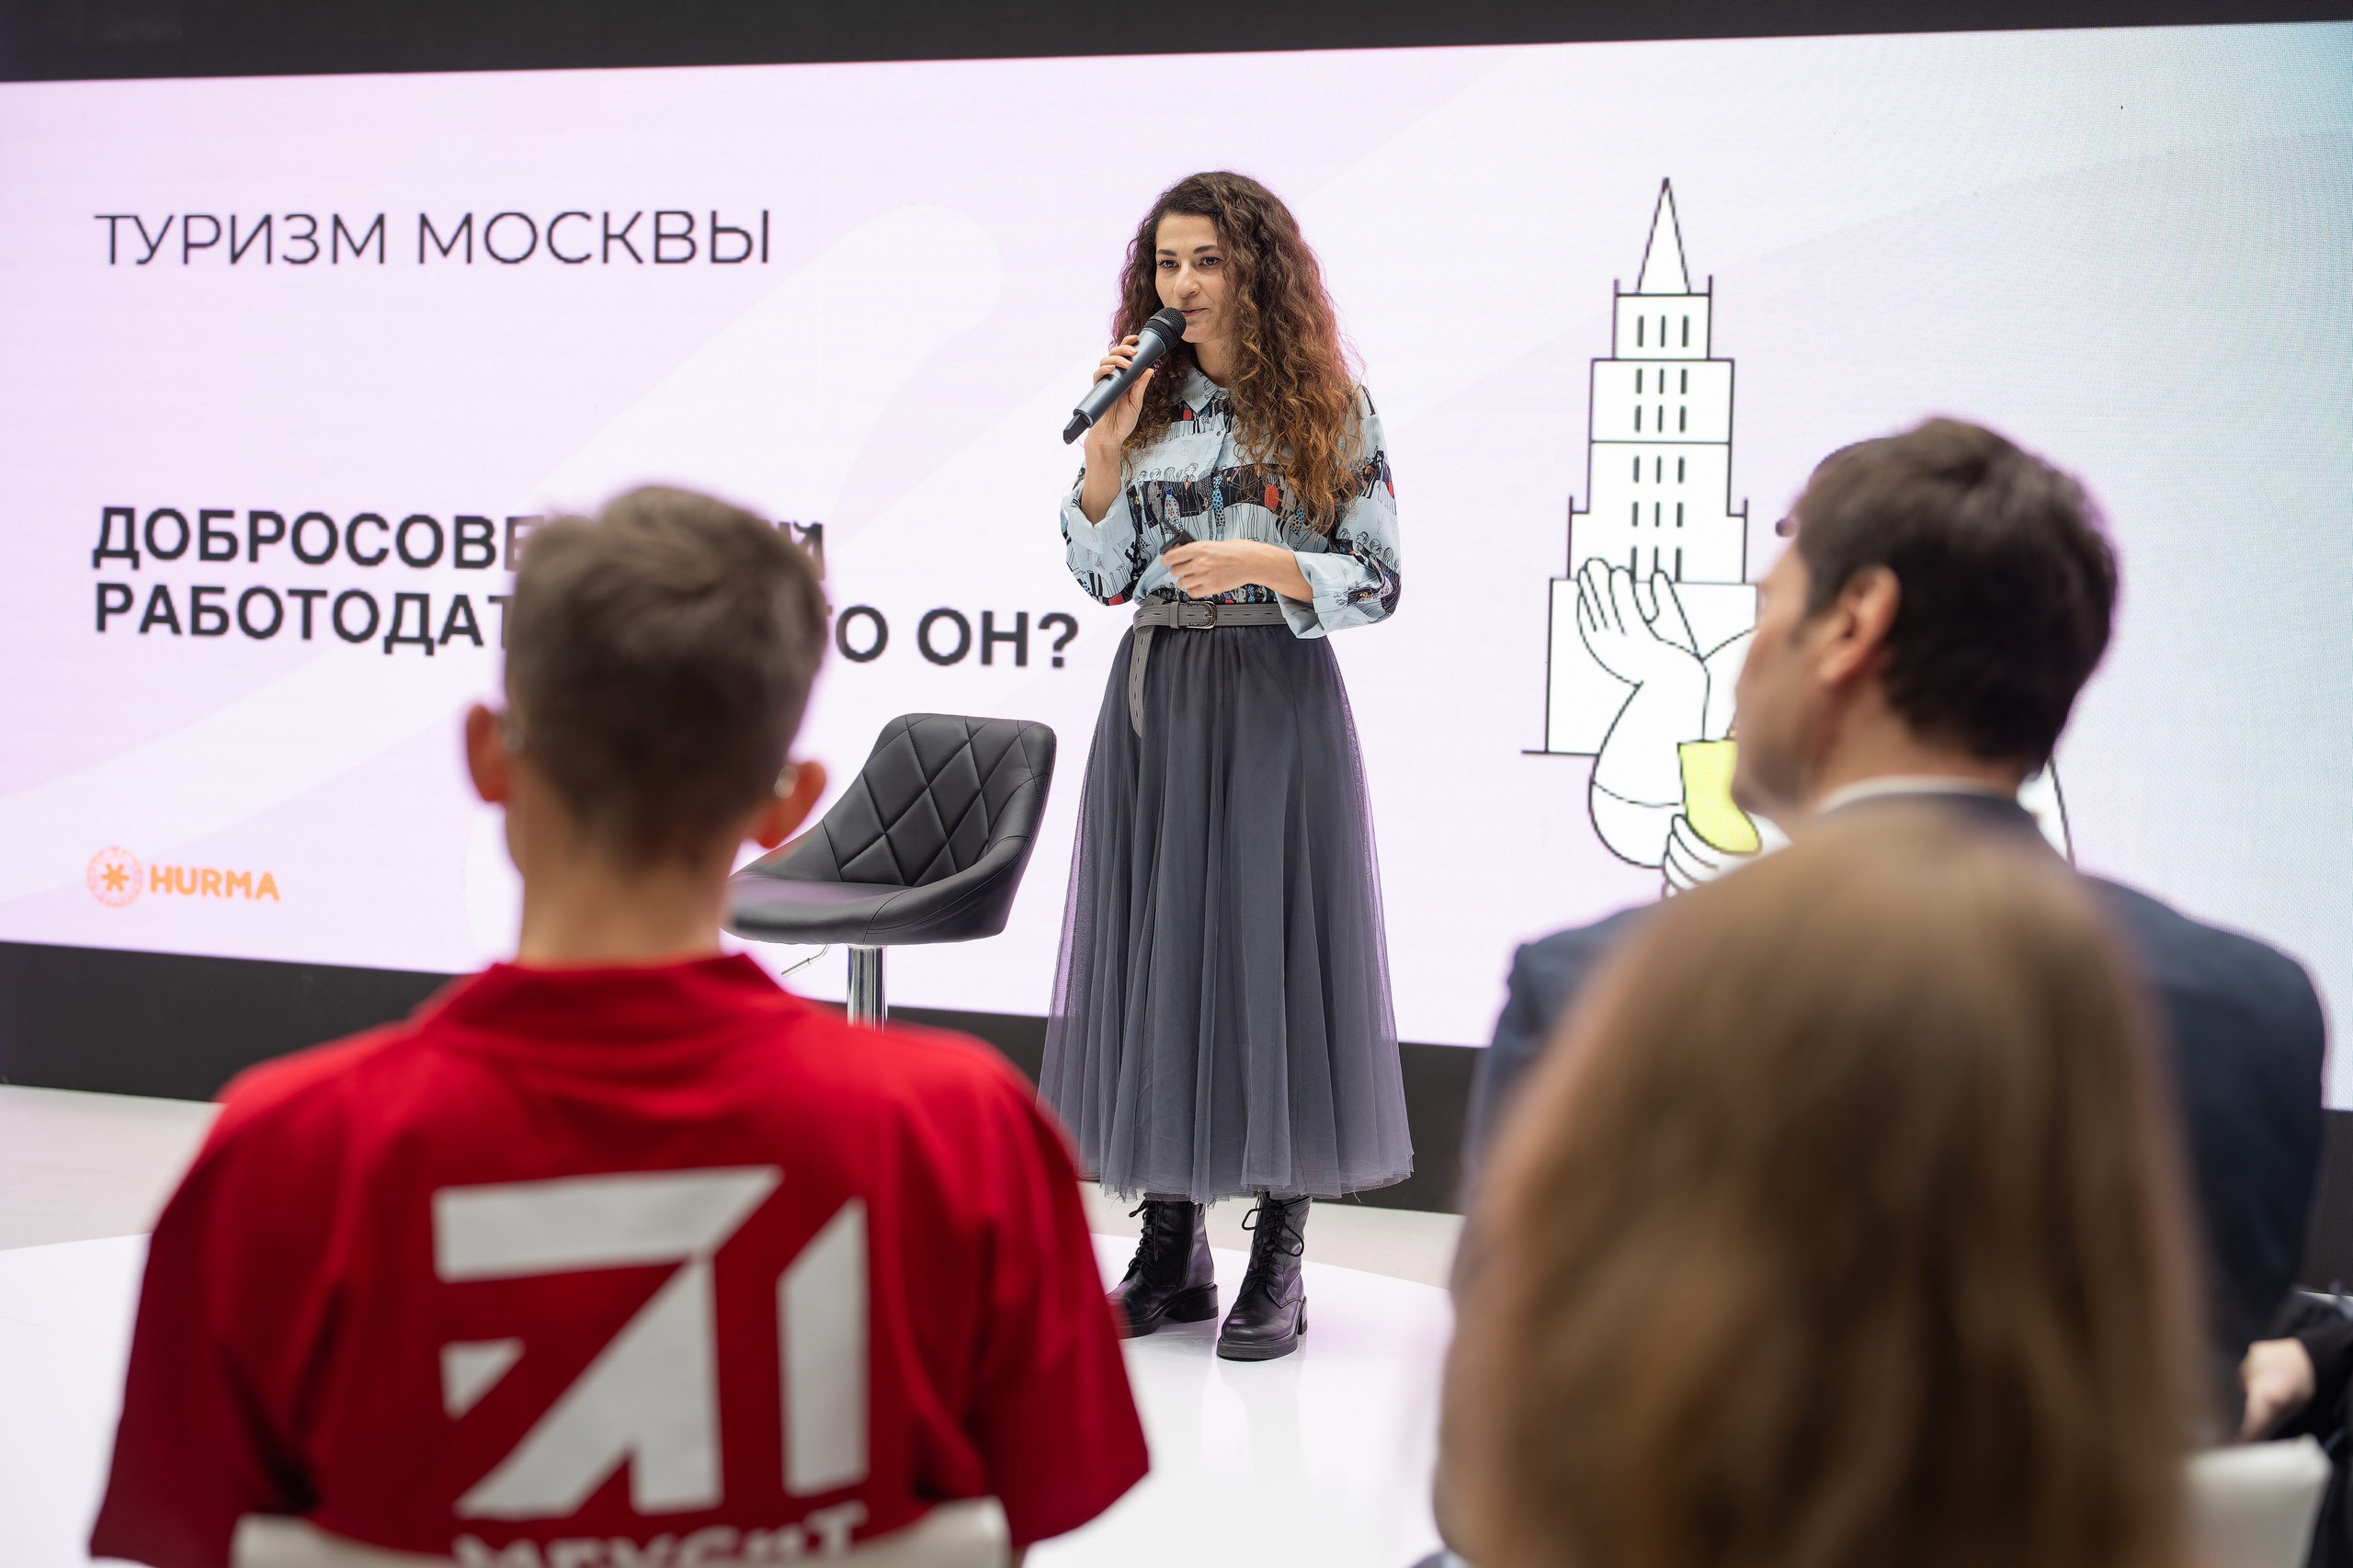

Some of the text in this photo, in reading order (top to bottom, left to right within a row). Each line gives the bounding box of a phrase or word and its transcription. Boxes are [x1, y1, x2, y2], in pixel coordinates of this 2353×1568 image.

[94, 209, 769, 265] ТУРИЗМ МОСКВЫ
[917, 607, 1079, 669] ОН?
[150, 864, 280, 902] HURMA
